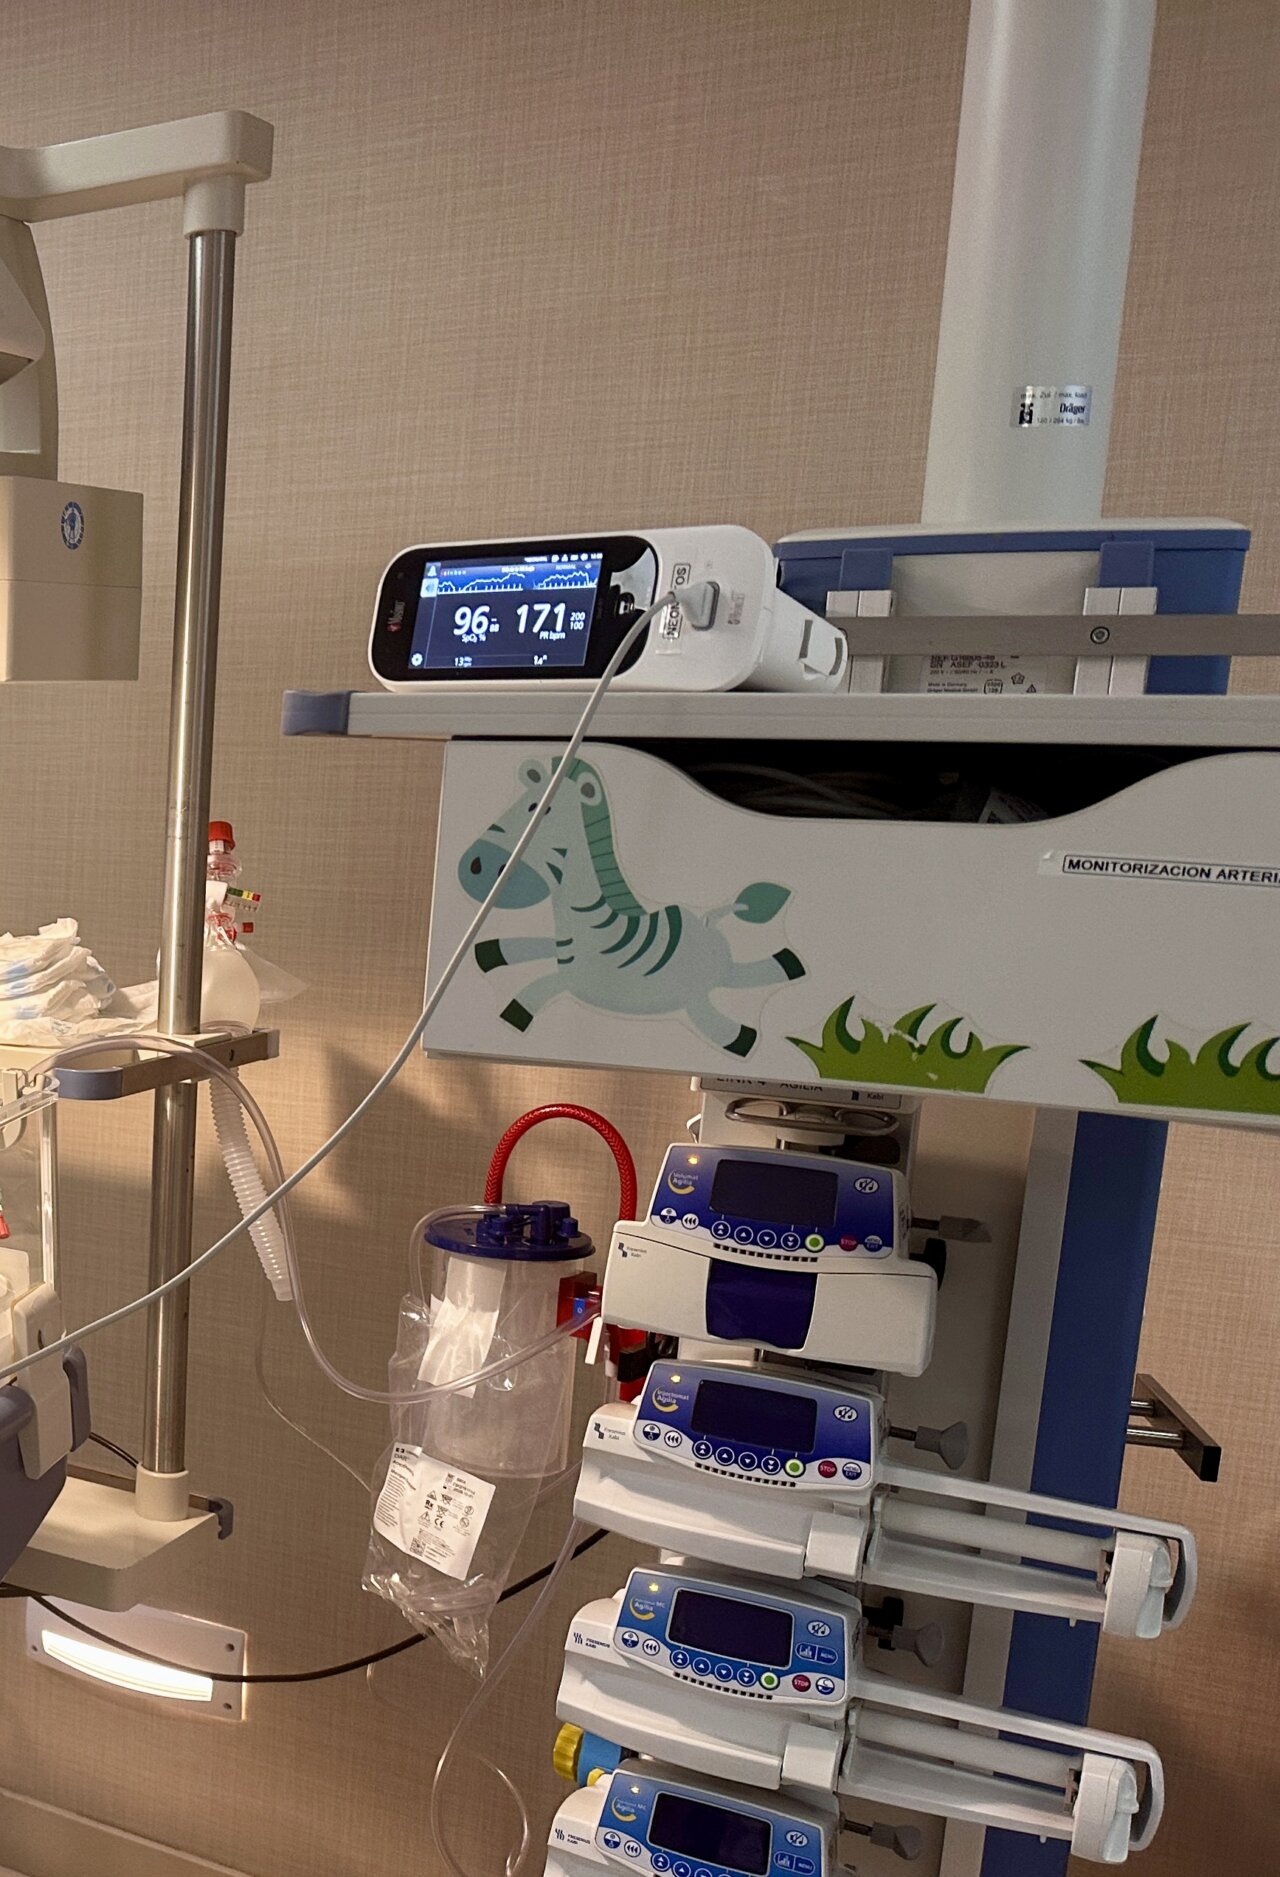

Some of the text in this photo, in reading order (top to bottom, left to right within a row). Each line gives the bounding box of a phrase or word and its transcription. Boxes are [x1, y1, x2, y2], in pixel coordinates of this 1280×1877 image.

[1060, 402, 1085, 415] Dräger
[666, 567, 687, 636] NEONOS
[453, 605, 490, 635] 96
[516, 602, 586, 633] 171 200
[570, 621, 584, 630] 100
[539, 630, 566, 640] PR bpm
[1067, 859, 1280, 884] MONITORIZACION ARTERI
[657, 1395, 677, 1404] Agilia
